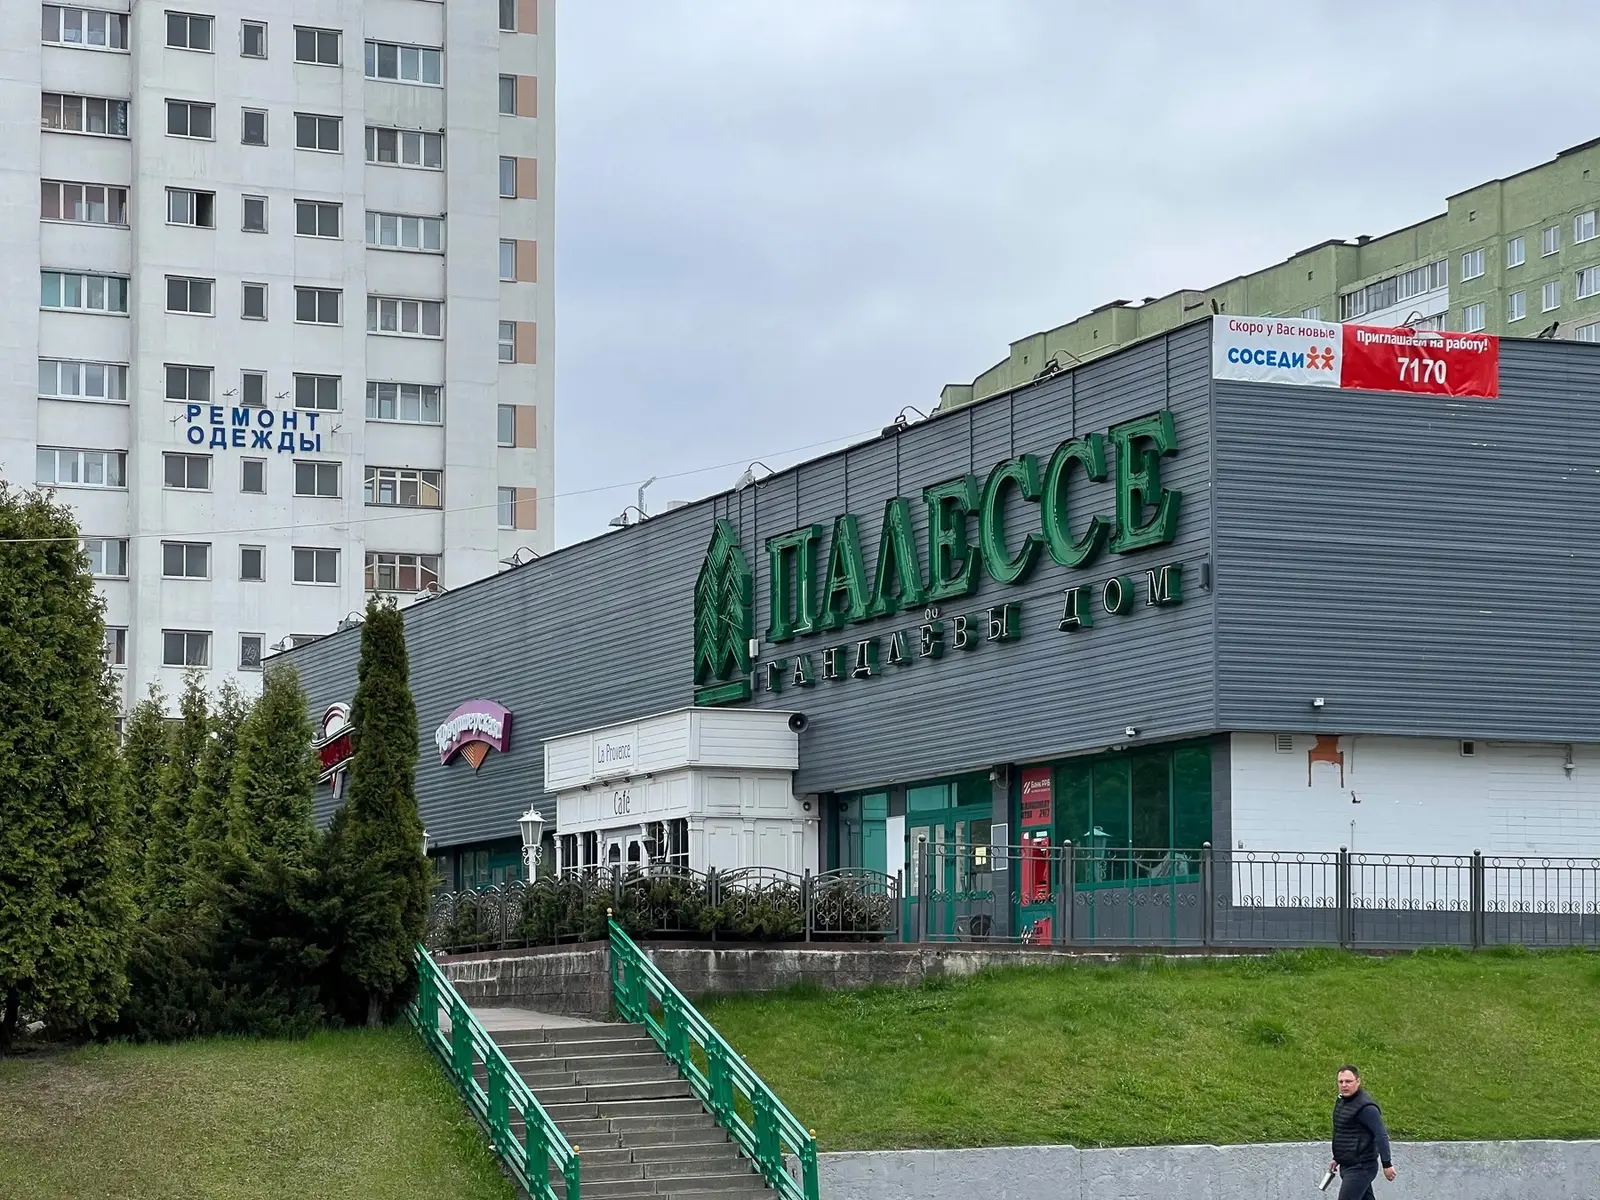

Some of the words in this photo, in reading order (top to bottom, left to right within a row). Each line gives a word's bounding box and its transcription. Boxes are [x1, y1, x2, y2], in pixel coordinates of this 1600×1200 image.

[1229, 319, 1264, 336] Скоро
[1267, 324, 1274, 337] у
[1276, 322, 1296, 336] Вас
[1298, 326, 1336, 339] новые
[1357, 329, 1427, 347] Приглашаем
[1430, 337, 1444, 349] на
[1446, 336, 1488, 354] работу!
[1228, 347, 1305, 369] СОСЕДИ
[1397, 356, 1447, 385] 7170
[187, 404, 320, 431] РЕМОНТ
[187, 425, 321, 454] ОДЕЖДЫ
[765, 409, 1182, 644] ПАЛЕССЕ
[1058, 562, 1183, 632] ДОМ
[597, 745, 605, 764] La
[613, 789, 631, 816] Café
